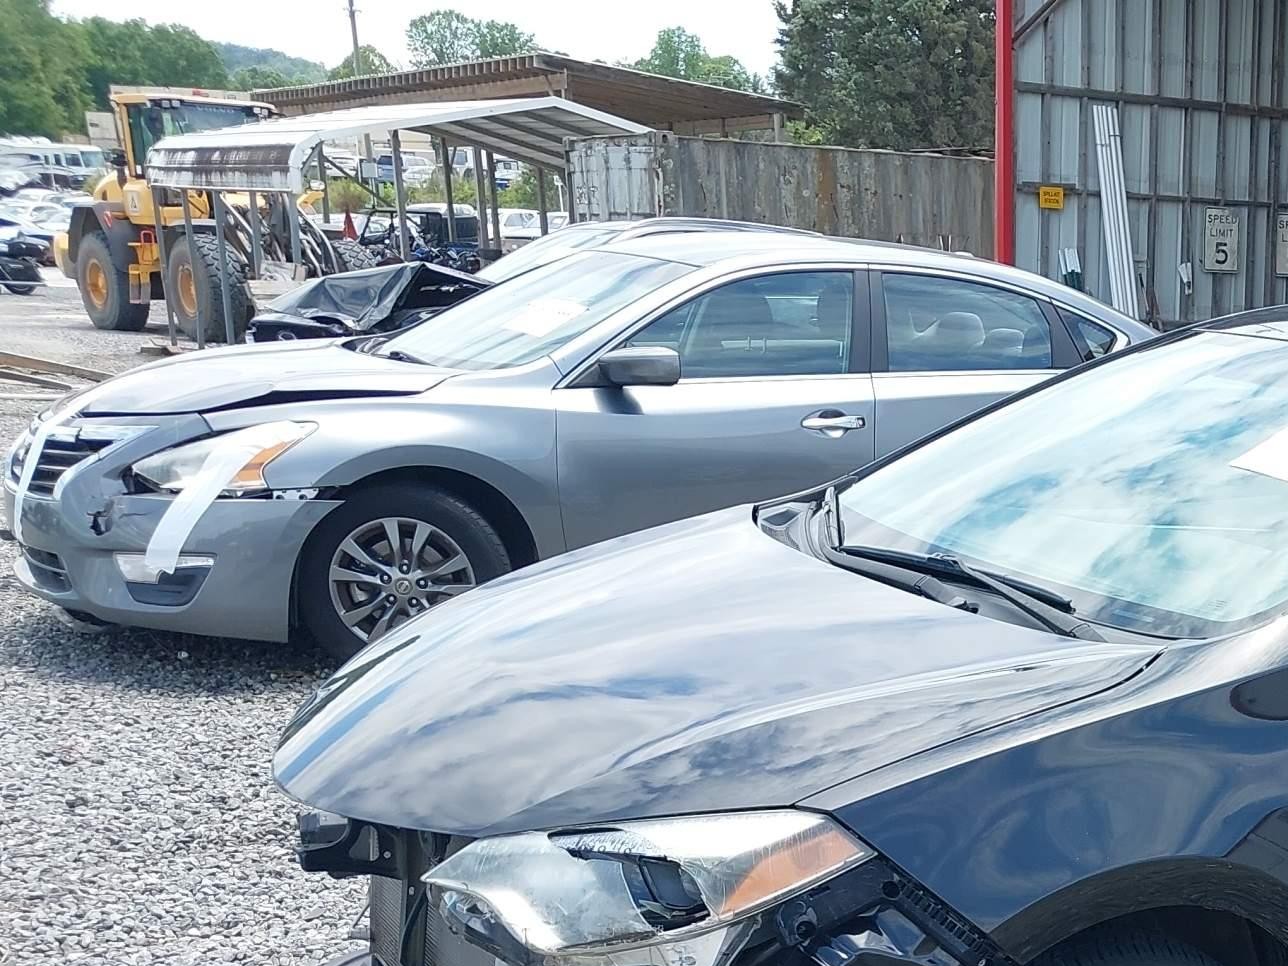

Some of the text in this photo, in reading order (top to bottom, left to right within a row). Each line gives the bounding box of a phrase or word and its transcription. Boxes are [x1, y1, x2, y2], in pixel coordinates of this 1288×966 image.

[1207, 214, 1238, 224] SPEED
[1210, 228, 1234, 238] LIMIT
[1215, 242, 1228, 264] 5
